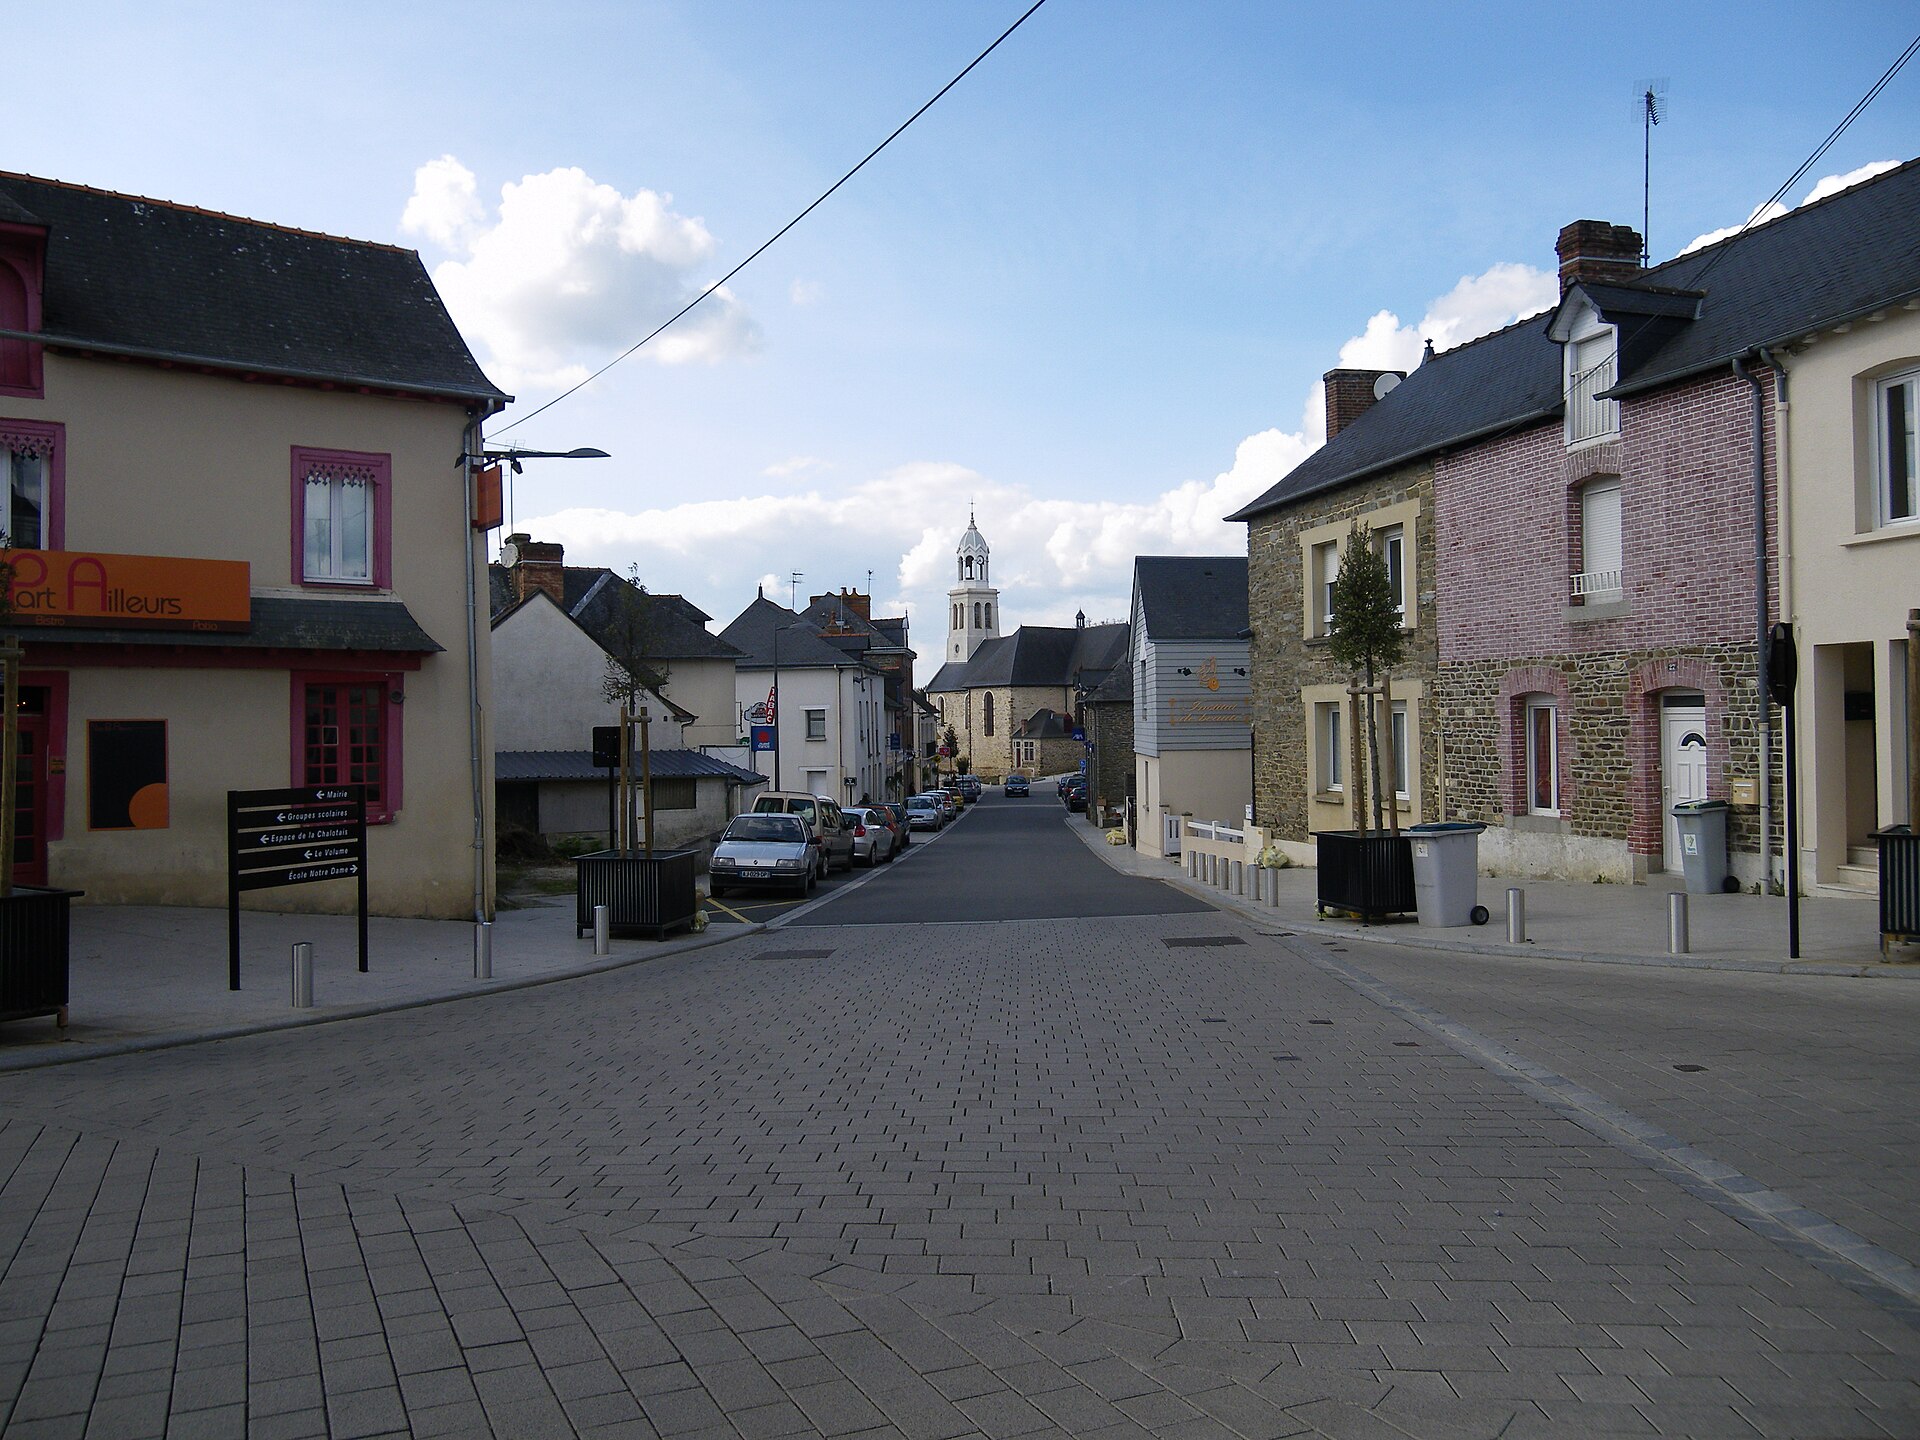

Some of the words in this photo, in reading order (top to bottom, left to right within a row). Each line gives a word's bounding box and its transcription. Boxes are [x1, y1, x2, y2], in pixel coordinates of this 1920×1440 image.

[67, 557, 182, 615] Ailleurs
[35, 615, 65, 626] Bistro
[192, 620, 218, 631] Patio
[767, 688, 775, 723] TABAC
[326, 790, 348, 799] Mairie
[287, 811, 316, 822] Groupes
[317, 809, 348, 818] scolaires
[270, 833, 296, 843] Espace
[297, 831, 306, 840] de
[308, 831, 315, 839] la
[317, 828, 348, 838] Chalotais
[314, 849, 322, 857] Le
[324, 847, 348, 856] Volume
[288, 869, 308, 880] École
[309, 867, 329, 877] Notre
[330, 866, 349, 875] Dame
